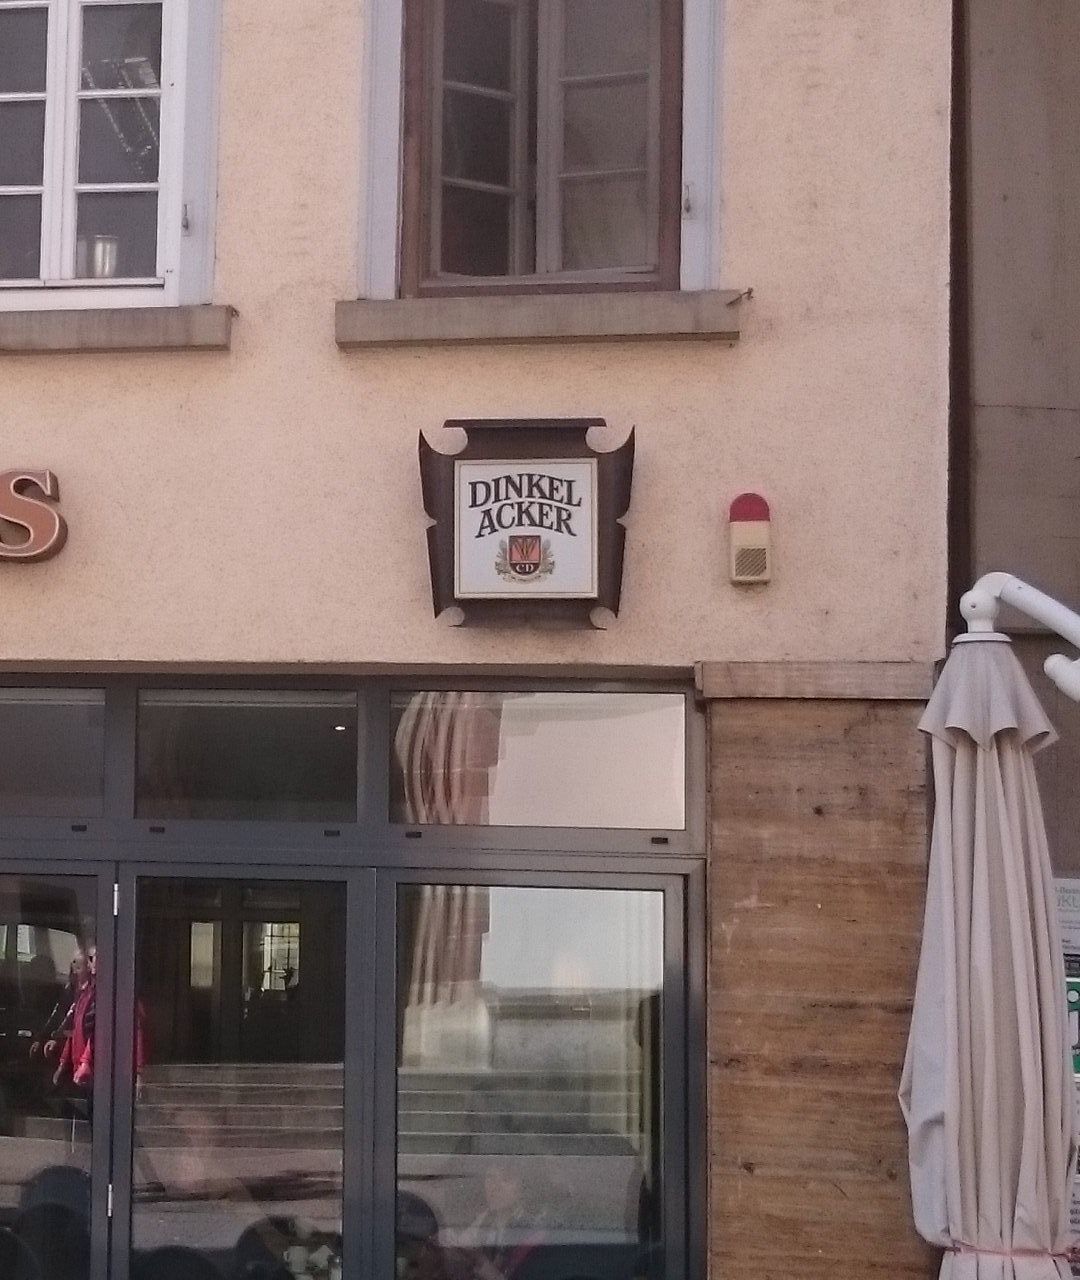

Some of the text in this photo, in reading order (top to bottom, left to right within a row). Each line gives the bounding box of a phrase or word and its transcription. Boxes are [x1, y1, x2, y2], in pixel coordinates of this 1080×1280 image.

[468, 473, 582, 508] DINKEL
[475, 501, 577, 538] ACKER
[516, 563, 534, 573] CD
